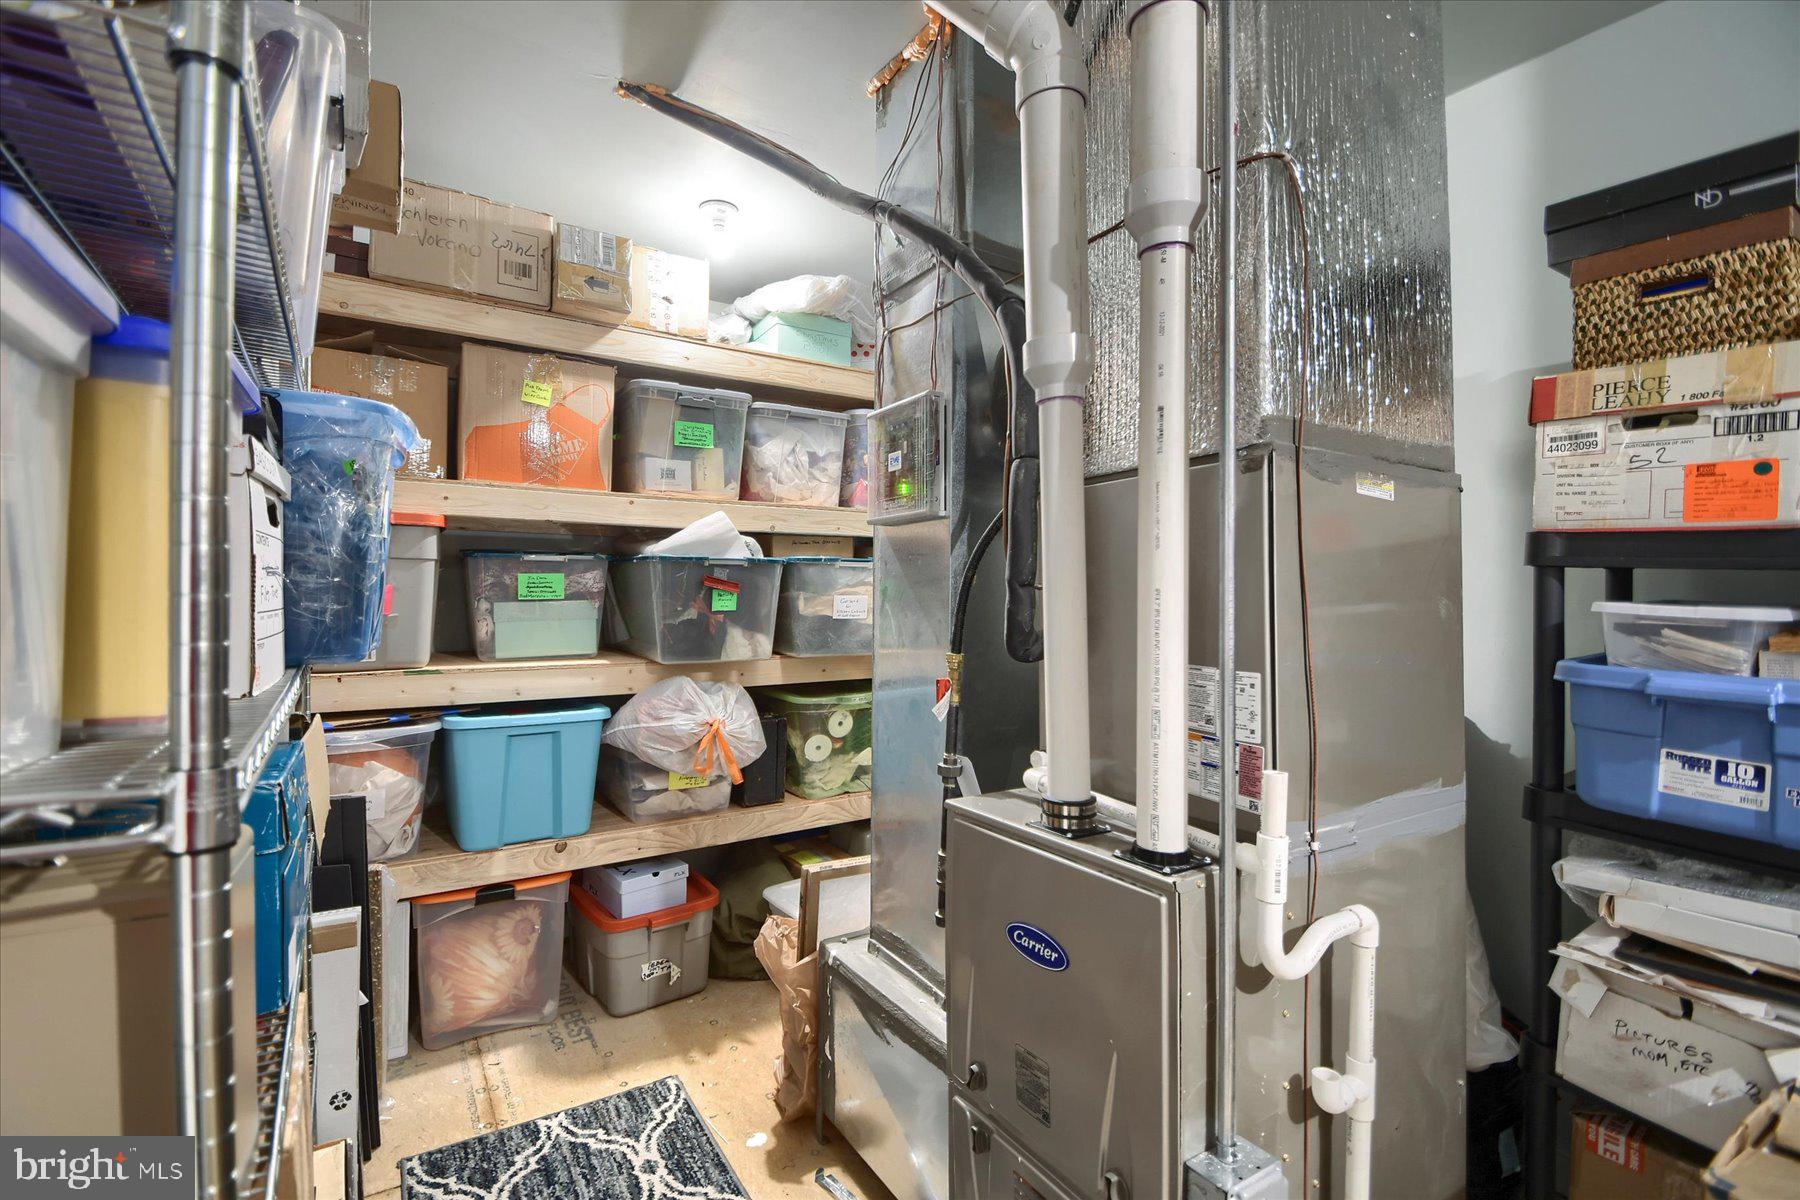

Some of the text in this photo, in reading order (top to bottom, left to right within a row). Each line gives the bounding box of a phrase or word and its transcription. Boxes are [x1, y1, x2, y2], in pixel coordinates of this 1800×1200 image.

[402, 204, 468, 232] chleich
[1592, 389, 1670, 410] LEAHY
[1593, 375, 1671, 397] PIERCE
[1689, 392, 1709, 401] 800
[1547, 440, 1598, 454] 44023099
[1721, 775, 1758, 787] GALLON
[1727, 762, 1754, 780] 10
[1014, 930, 1058, 961] Carrier
[562, 1010, 592, 1044] BEST
[1615, 1019, 1713, 1063] PICTURES
